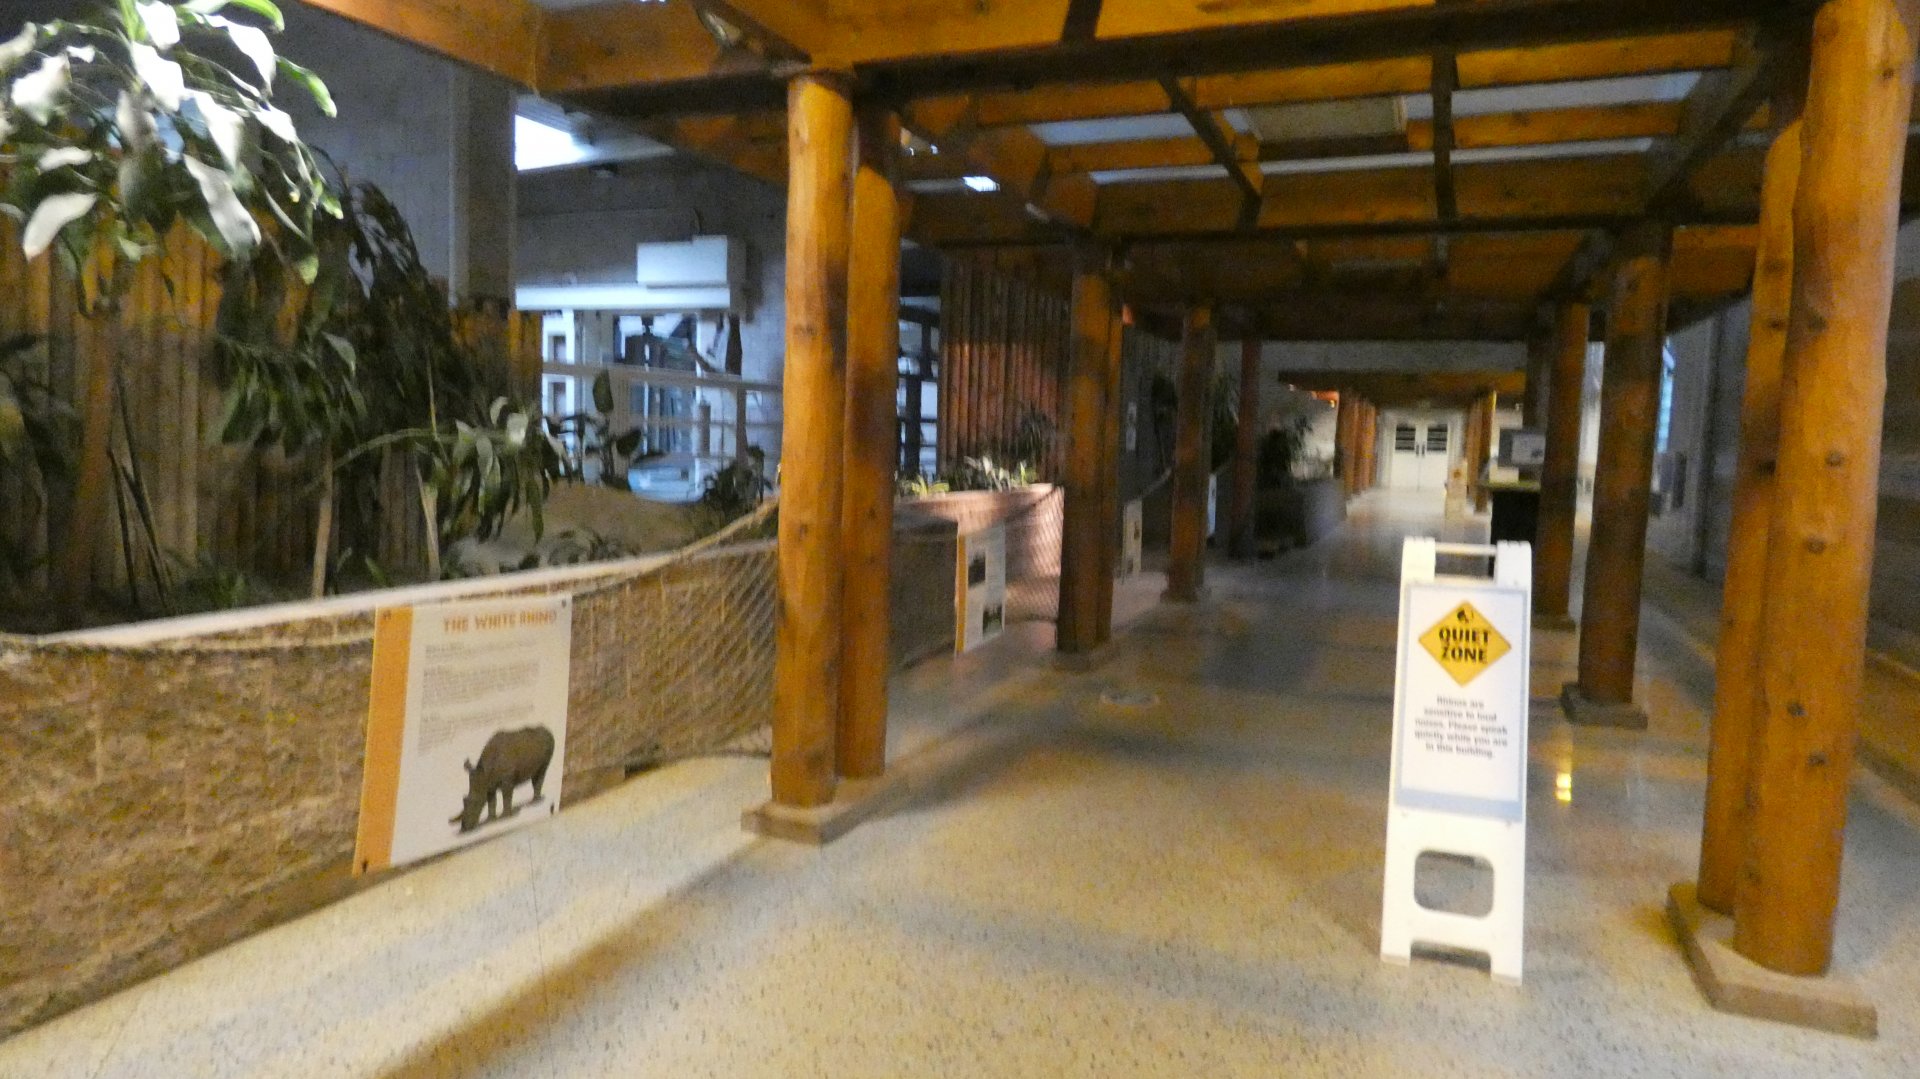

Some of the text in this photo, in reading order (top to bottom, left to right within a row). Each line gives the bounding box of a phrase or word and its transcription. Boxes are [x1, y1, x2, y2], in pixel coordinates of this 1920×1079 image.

[443, 607, 557, 632] THE WHITE RHINO
[1439, 627, 1490, 644] QUIET
[1441, 645, 1488, 663] ZONE
[1437, 695, 1467, 707] Rhinos
[1424, 708, 1463, 719] sensitive
[1477, 713, 1497, 721] loud
[1449, 720, 1478, 731] Please
[1481, 725, 1508, 735] speak
[1415, 730, 1443, 740] quietly
[1447, 733, 1471, 742] while
[1474, 736, 1490, 745] you
